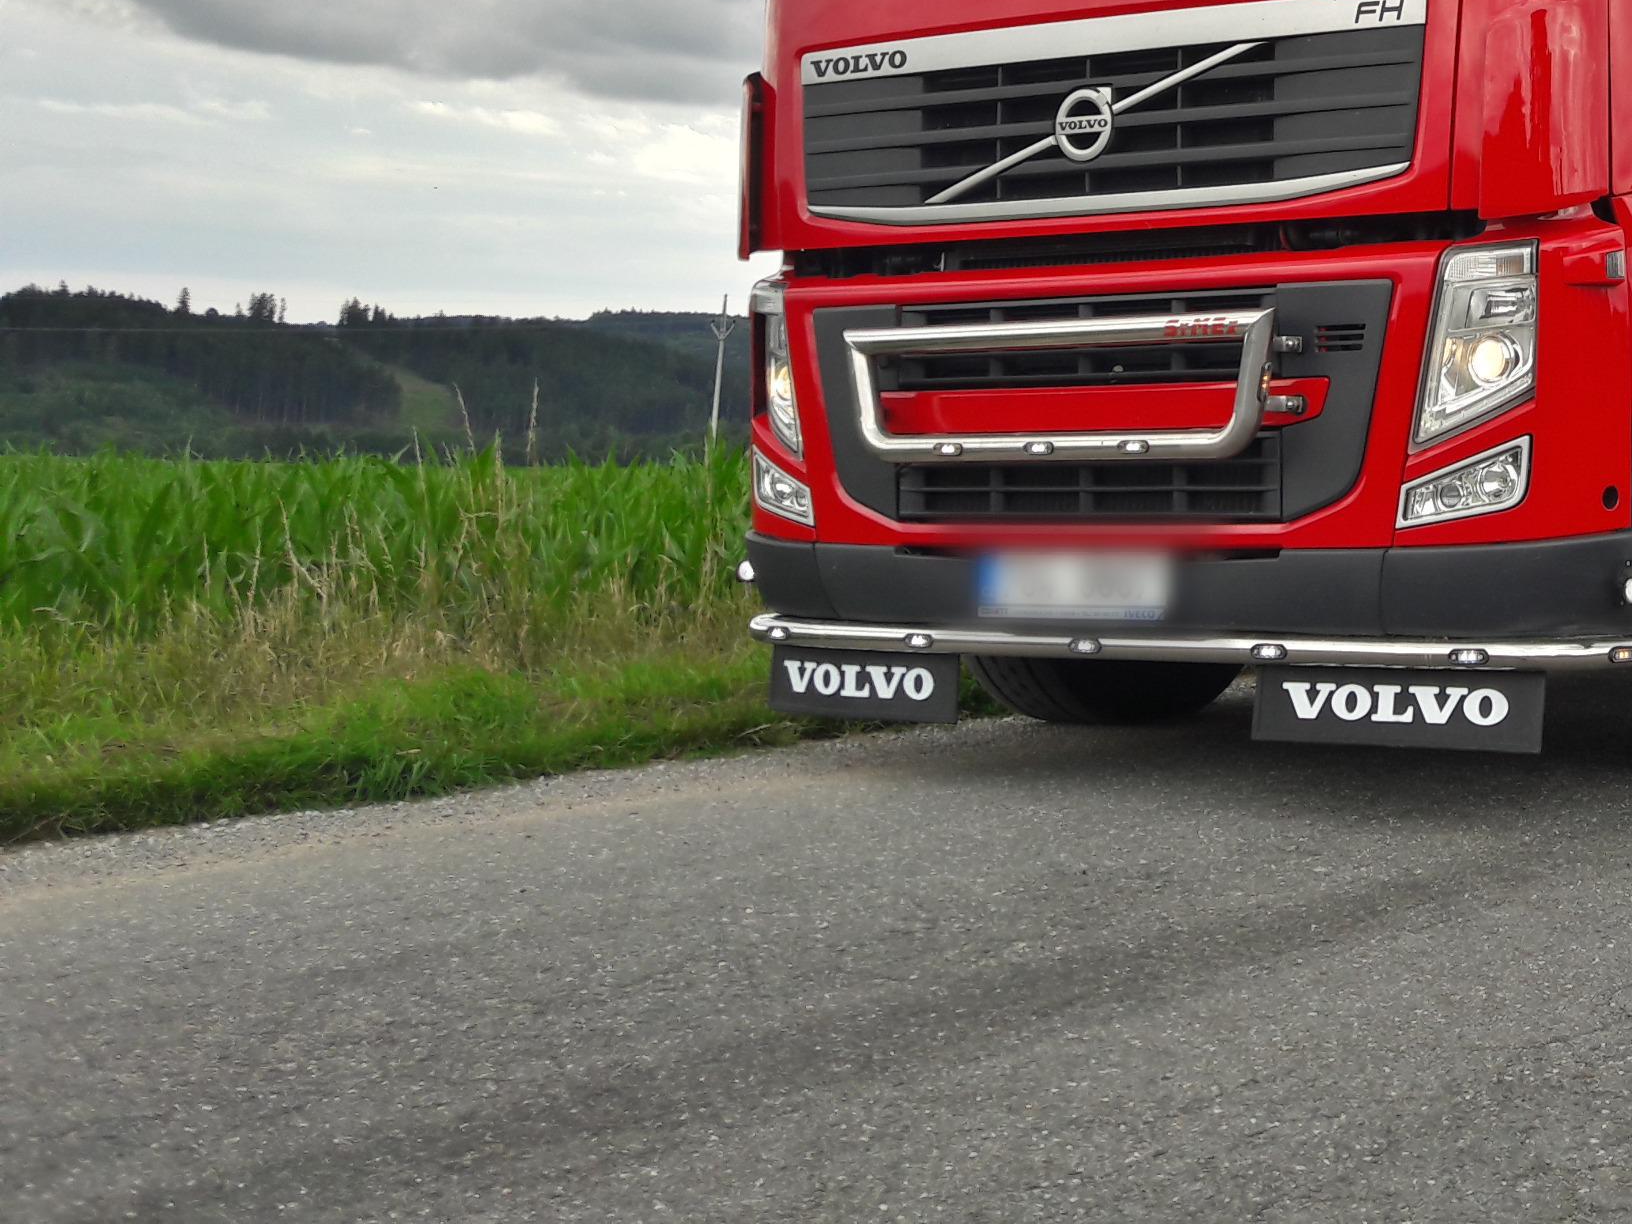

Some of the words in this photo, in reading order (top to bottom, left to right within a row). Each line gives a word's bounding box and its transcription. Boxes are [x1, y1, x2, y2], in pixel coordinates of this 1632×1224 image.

[810, 49, 907, 78] VOLVO
[1058, 118, 1108, 131] VOLVO
[783, 659, 935, 701] VOLVO
[1282, 682, 1509, 726] VOLVO
